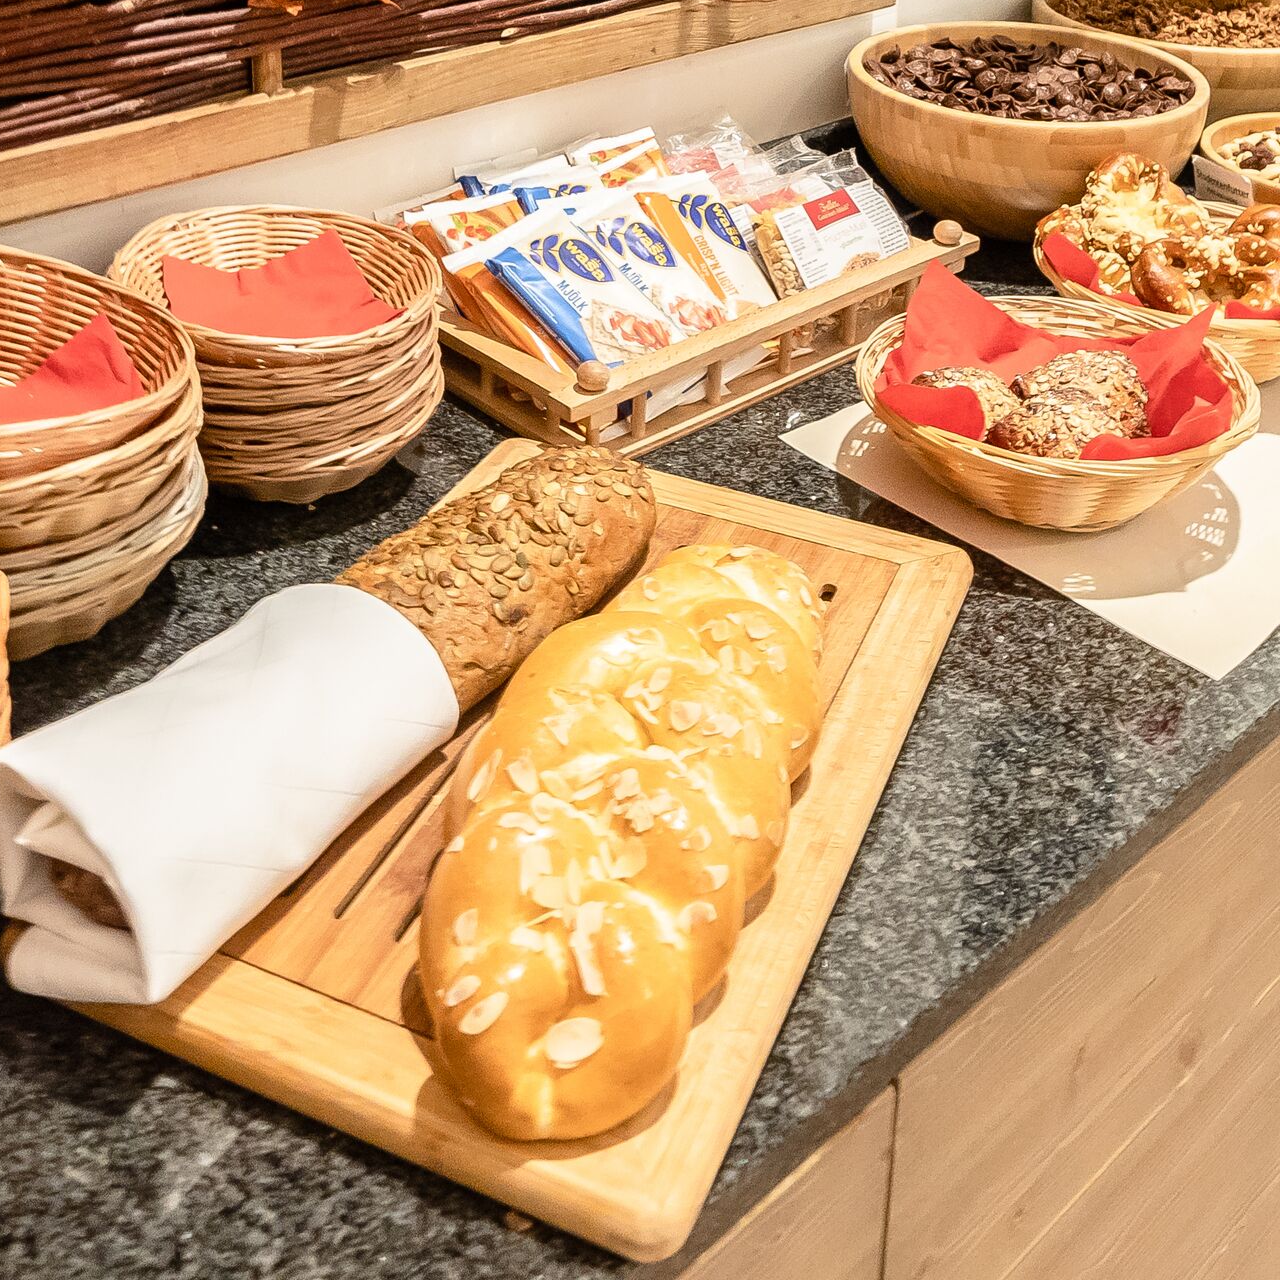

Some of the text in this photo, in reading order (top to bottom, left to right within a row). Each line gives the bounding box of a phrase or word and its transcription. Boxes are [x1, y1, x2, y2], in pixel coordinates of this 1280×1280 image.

[619, 262, 649, 293] MJÖLK
[694, 235, 721, 270] CRISP'N
[715, 270, 739, 296] LIGHT
[556, 279, 588, 312] MJÖLK
